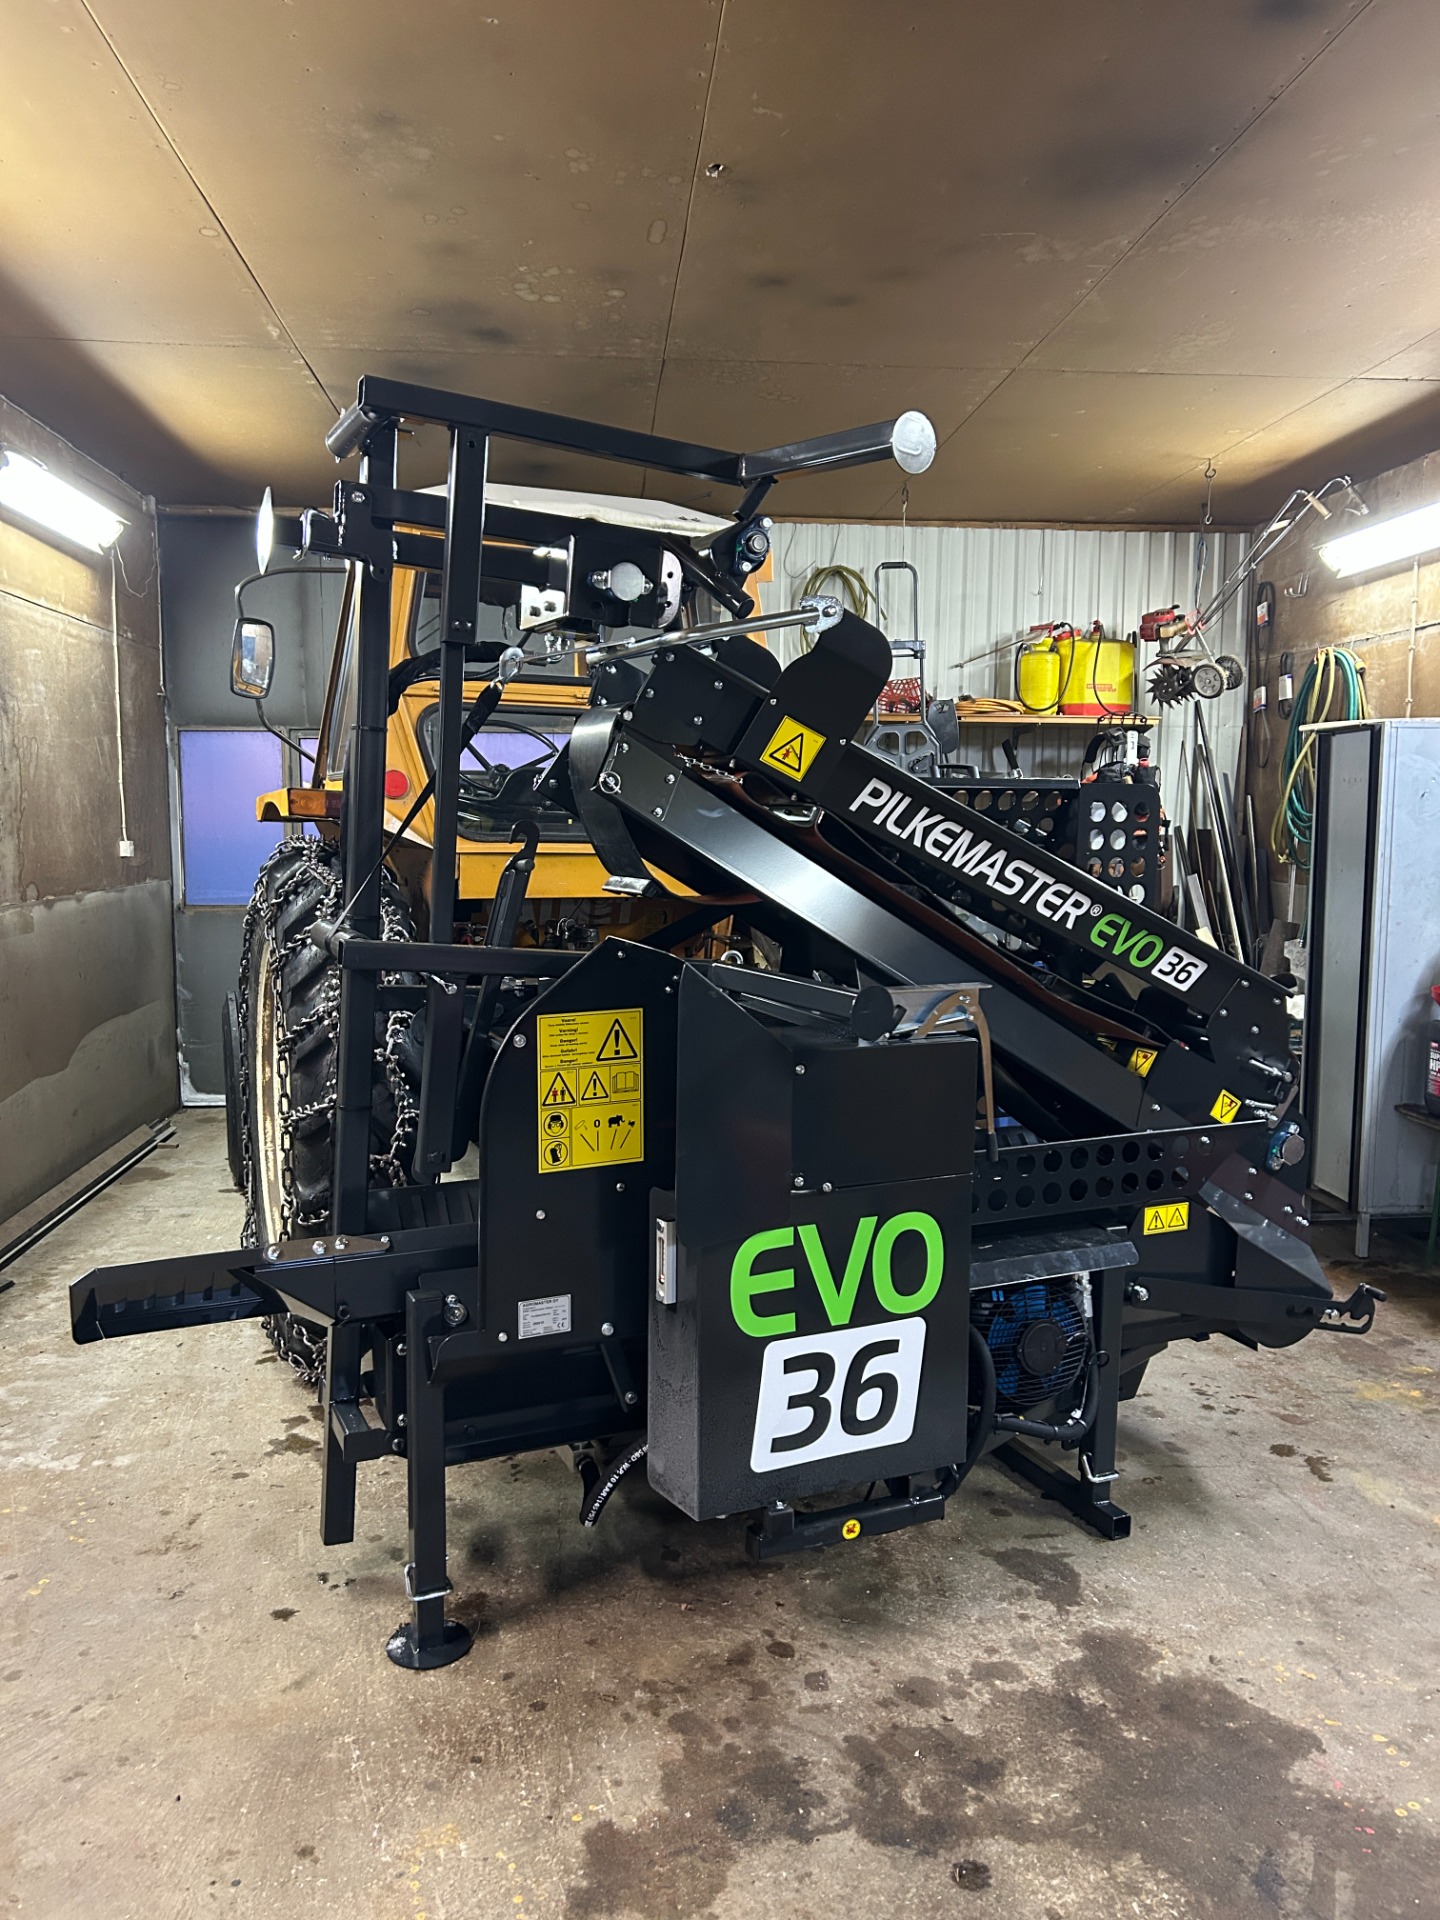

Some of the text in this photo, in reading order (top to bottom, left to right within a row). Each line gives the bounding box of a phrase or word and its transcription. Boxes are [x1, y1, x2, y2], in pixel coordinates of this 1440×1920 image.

[1090, 913, 1164, 968] EVO
[1157, 951, 1199, 985] 36
[730, 1211, 944, 1337] EVO
[770, 1339, 900, 1453] 36
[600, 1482, 613, 1497] BAR
[610, 1474, 619, 1483] 10
